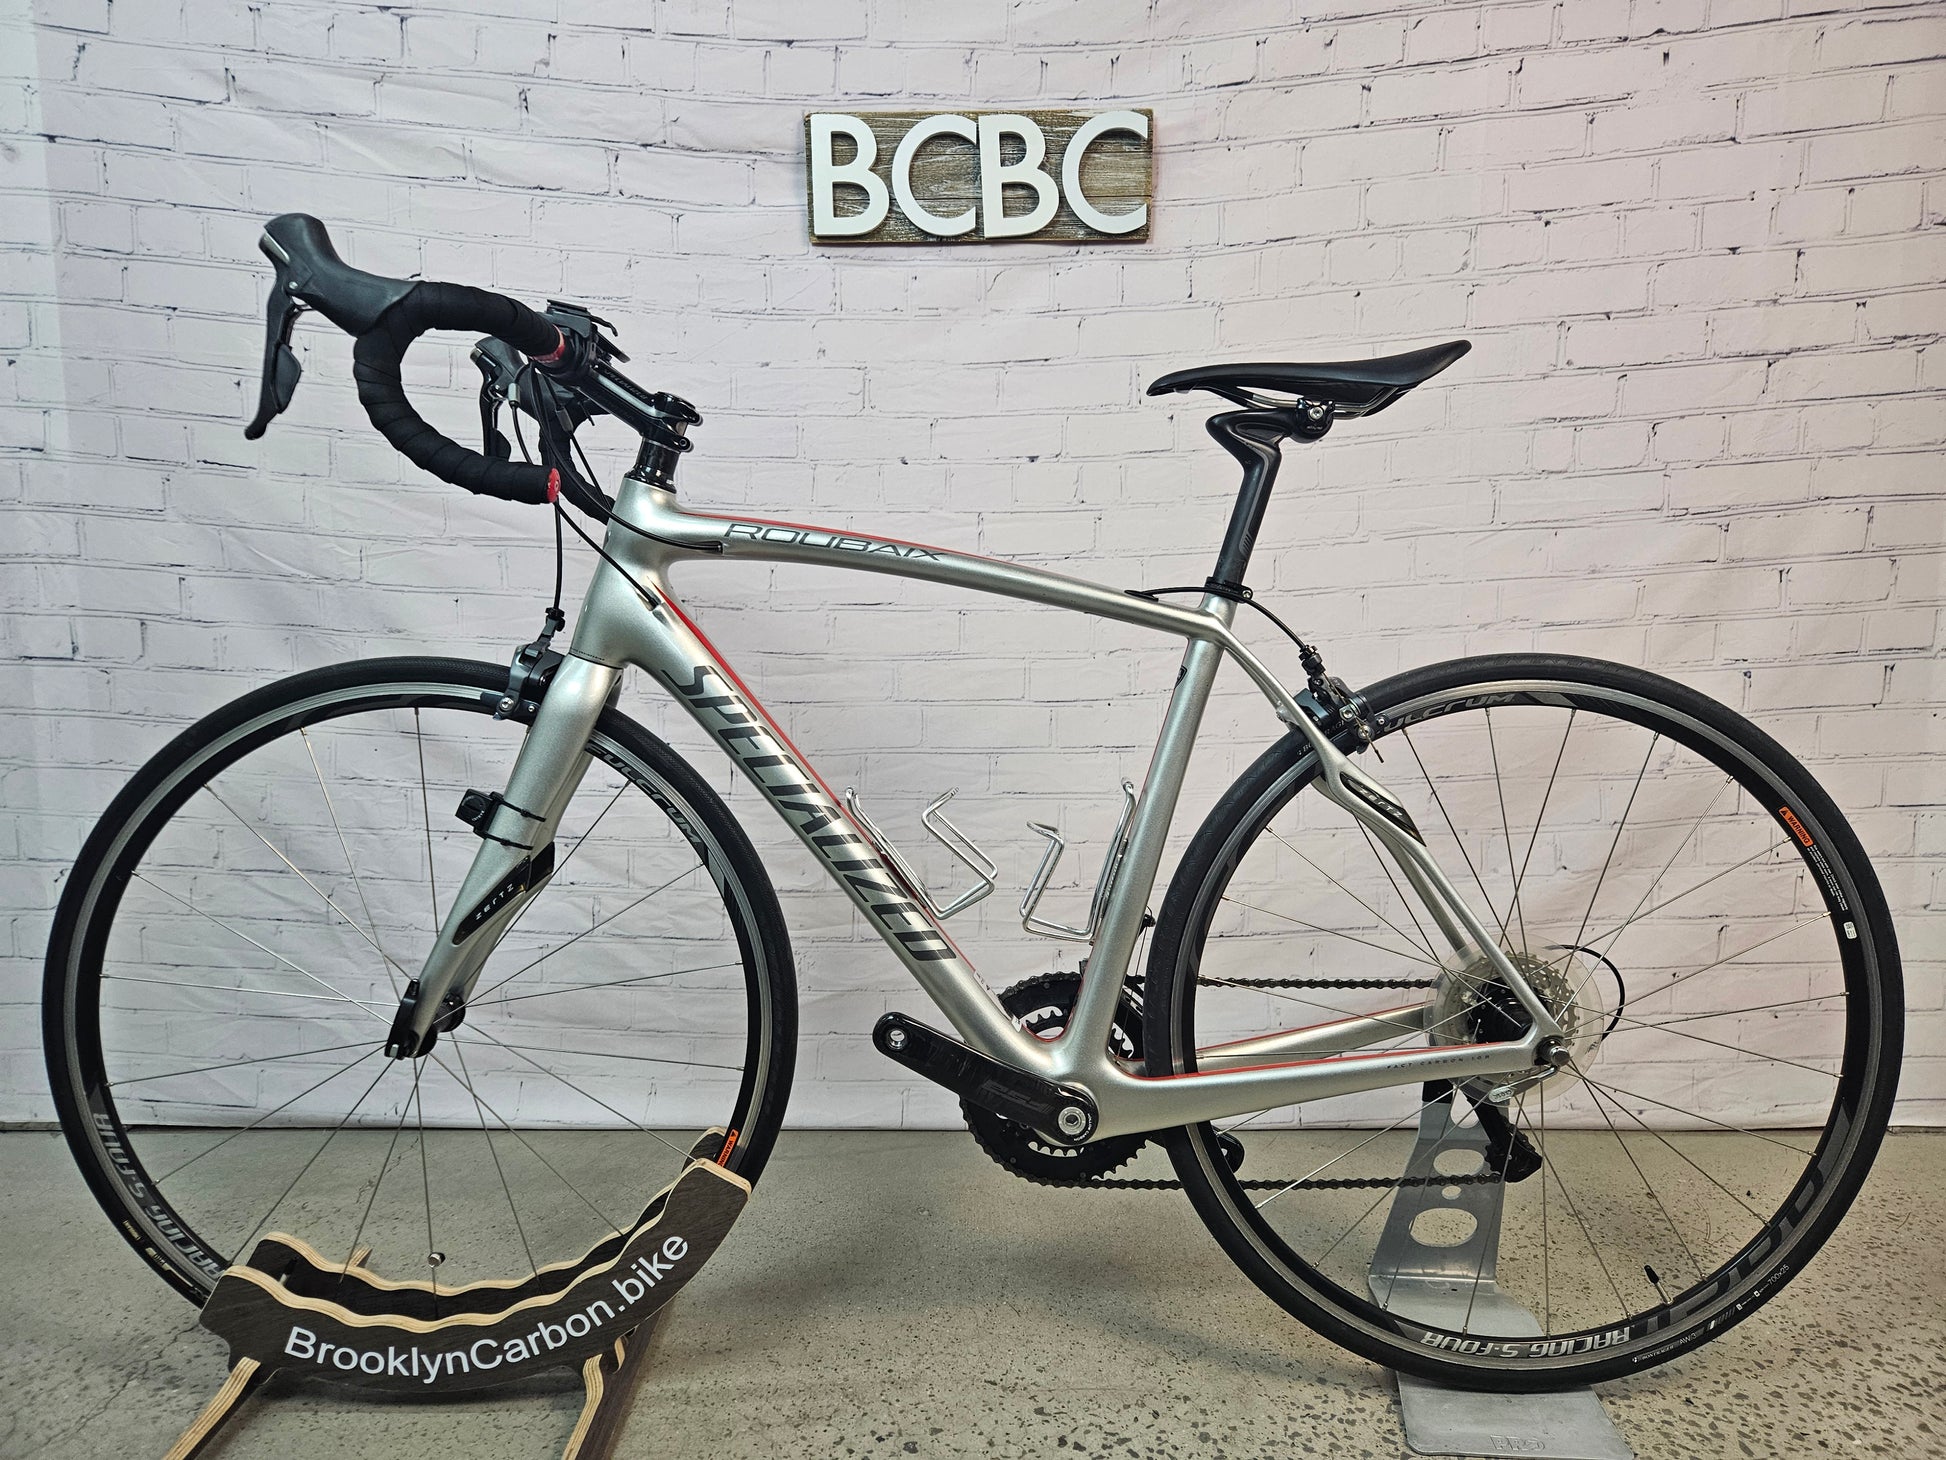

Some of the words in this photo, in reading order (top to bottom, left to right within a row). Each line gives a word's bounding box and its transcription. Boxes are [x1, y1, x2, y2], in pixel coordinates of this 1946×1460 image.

[810, 111, 1148, 238] BCBC
[723, 523, 947, 561] ROUBAIX
[1378, 693, 1516, 733] ULCRUM
[283, 1234, 689, 1385] BrooklynCarbon.bike
[1528, 1326, 1632, 1359] RACING
